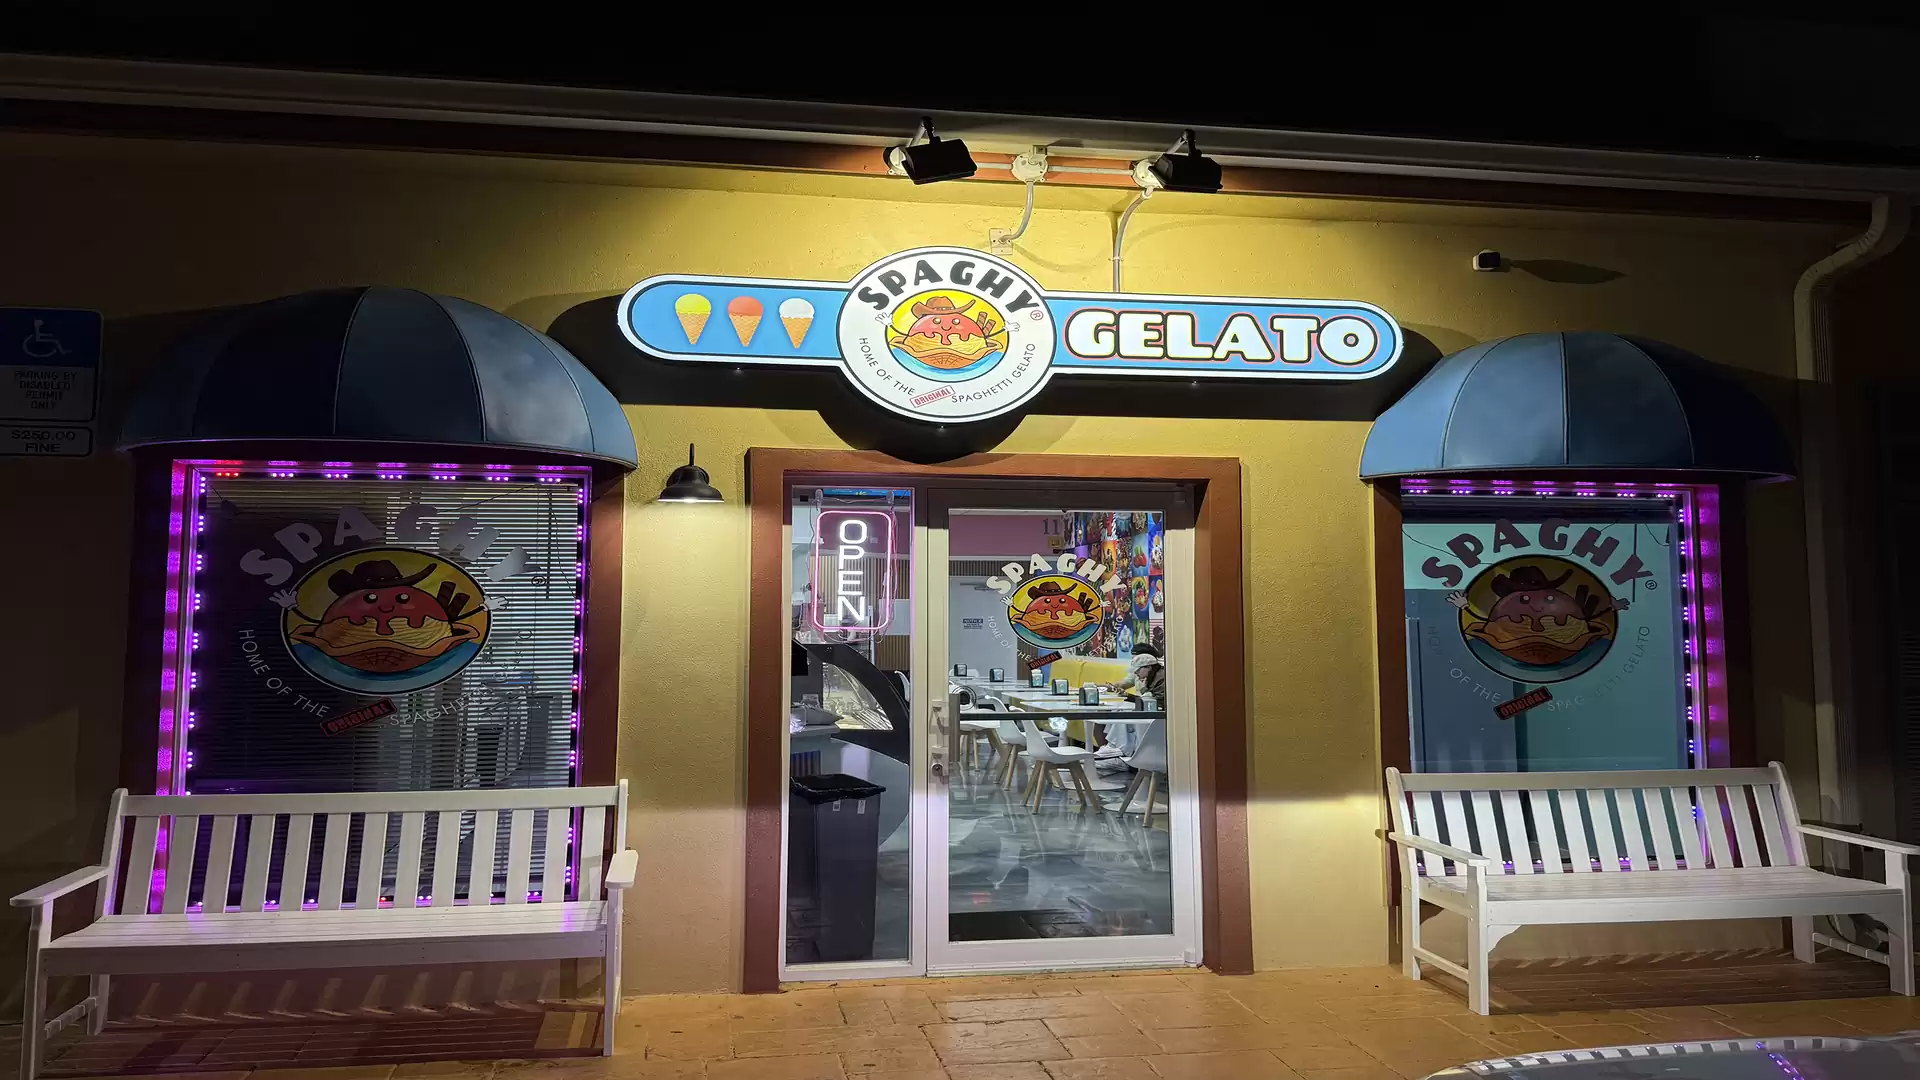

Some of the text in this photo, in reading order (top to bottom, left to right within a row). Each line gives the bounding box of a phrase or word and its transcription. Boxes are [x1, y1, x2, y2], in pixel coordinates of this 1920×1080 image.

[858, 259, 1039, 313] SPAGHY
[1065, 308, 1380, 367] GELATO
[63, 371, 77, 381] BY
[858, 337, 1036, 406] HOME OF THE ORIGINAL SPAGHETTI GELATO
[30, 399, 57, 410] ONLY
[25, 442, 62, 453] FINE
[838, 519, 868, 621] OPEN
[986, 553, 1127, 595] SPAGHY
[1421, 518, 1653, 588] SPAGHY
[238, 629, 271, 676] HOME
[265, 676, 293, 696] OF
[293, 693, 331, 719] THE
[1450, 667, 1472, 684] OF
[1472, 683, 1502, 703] THE
[1499, 690, 1548, 717] ORIGINAL
[1622, 626, 1650, 674] GELATO
